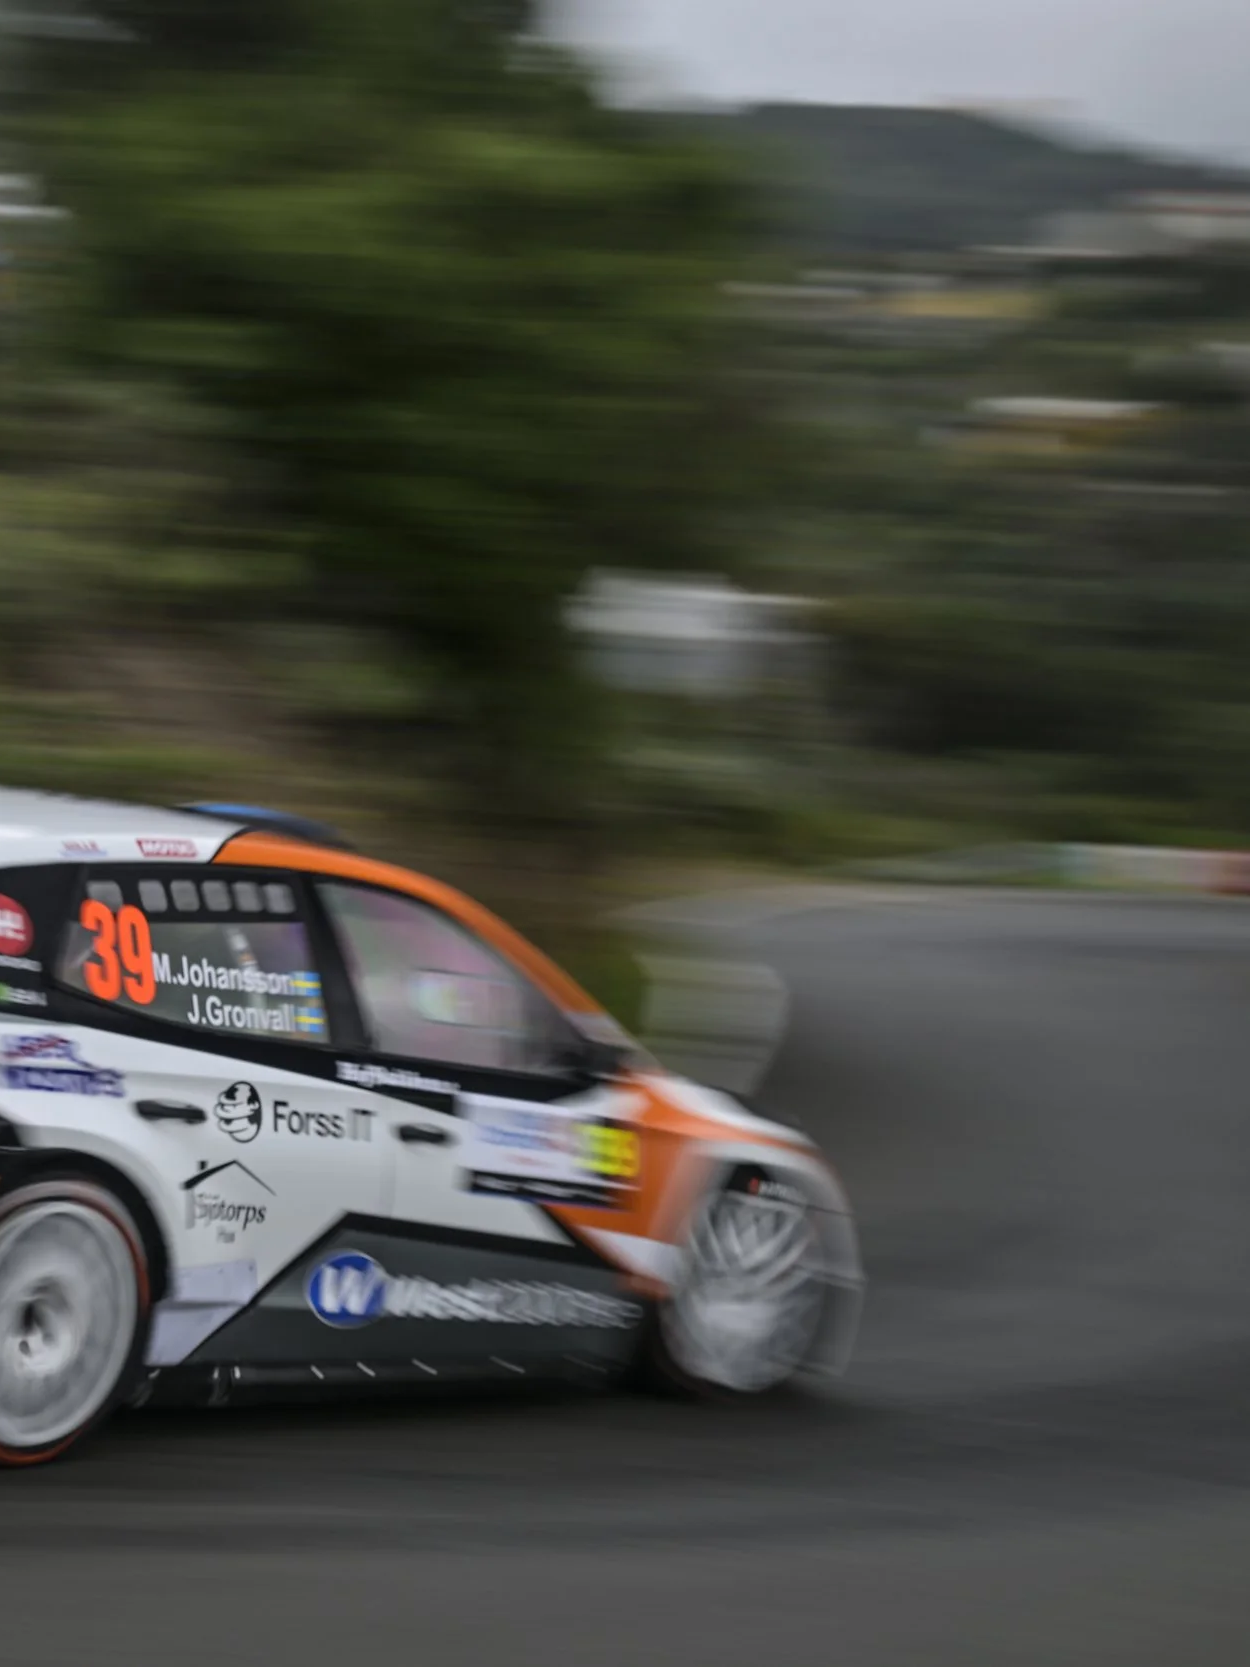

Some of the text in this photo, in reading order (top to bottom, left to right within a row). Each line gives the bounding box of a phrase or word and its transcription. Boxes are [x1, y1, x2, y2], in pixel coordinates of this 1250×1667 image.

[80, 898, 156, 1005] 39
[151, 951, 296, 996] M.Johansson
[187, 993, 296, 1032] J.Gronvall
[273, 1100, 377, 1142] Forss IT
